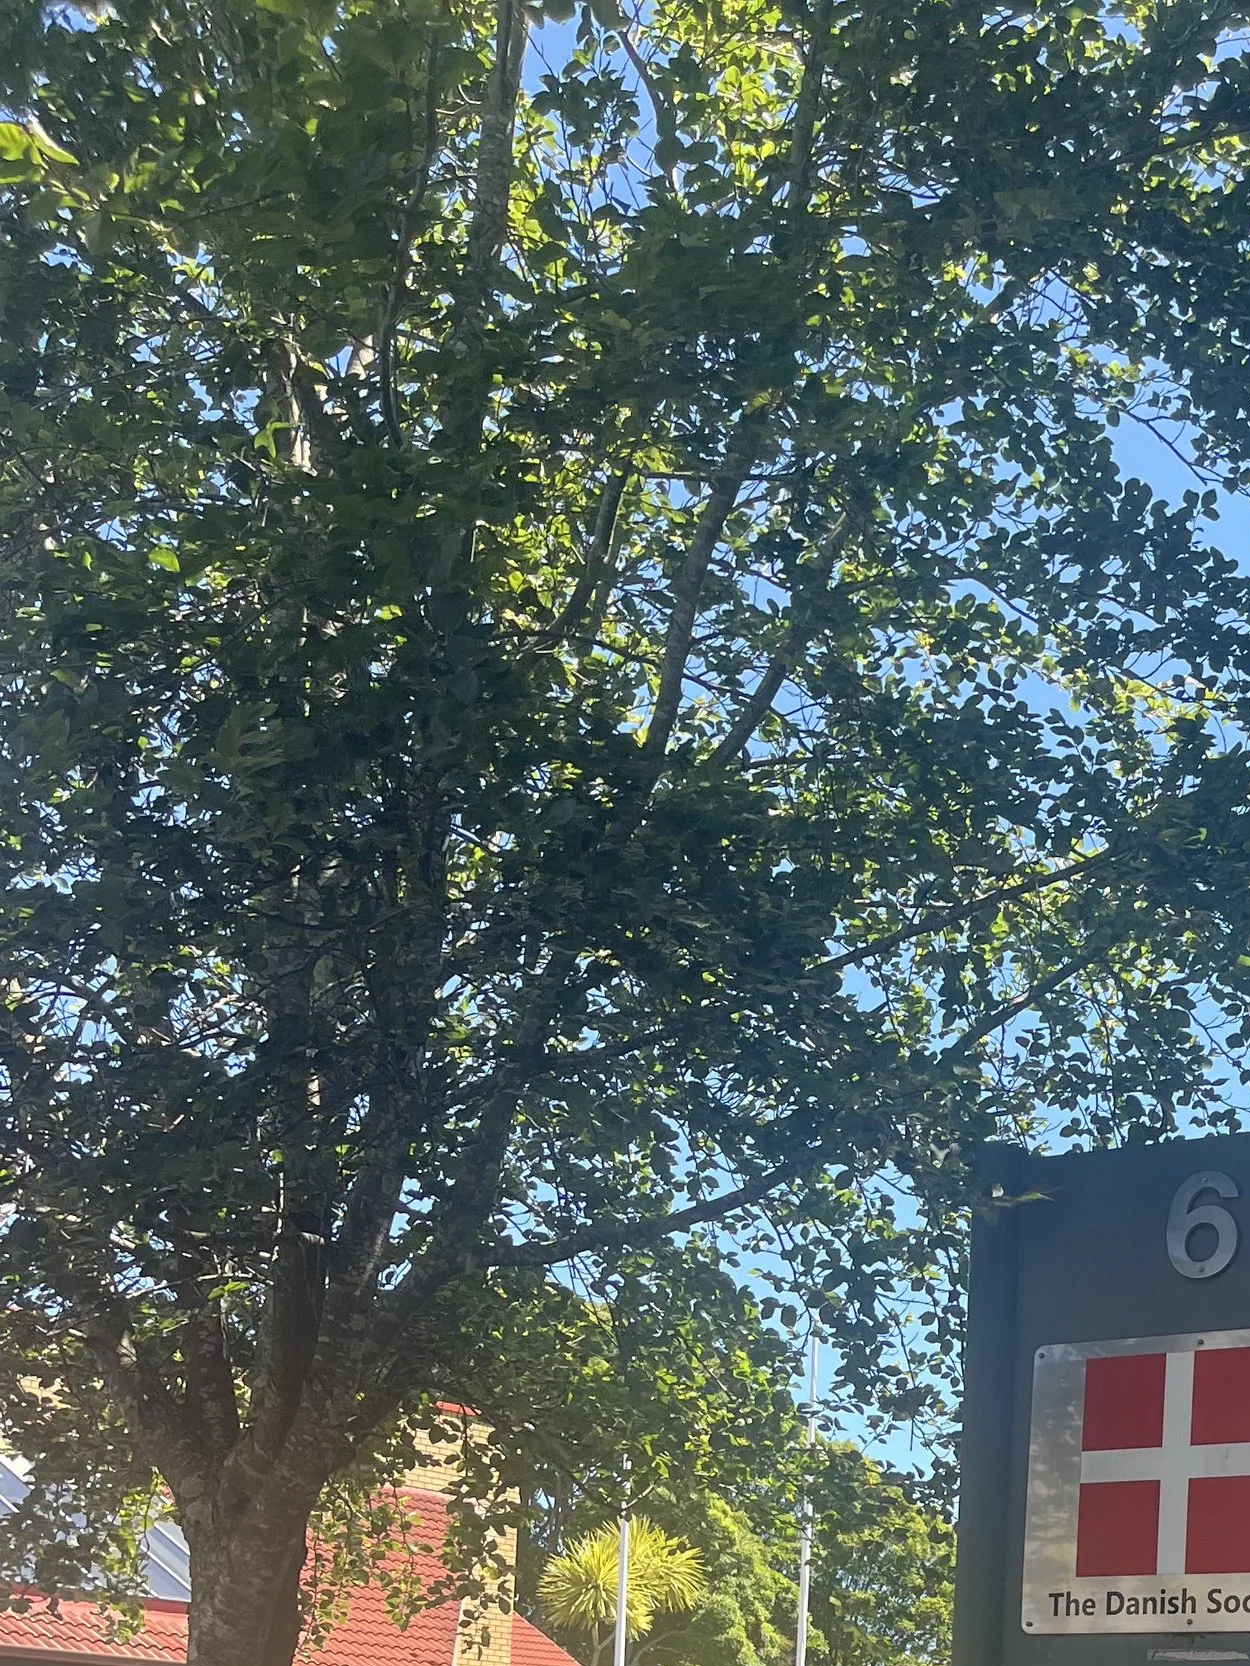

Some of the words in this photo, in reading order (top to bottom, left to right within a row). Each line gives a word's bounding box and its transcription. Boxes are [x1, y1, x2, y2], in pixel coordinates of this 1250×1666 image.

[1166, 1170, 1239, 1279] 6
[1048, 1591, 1096, 1617] The
[1105, 1588, 1197, 1616] Danish
